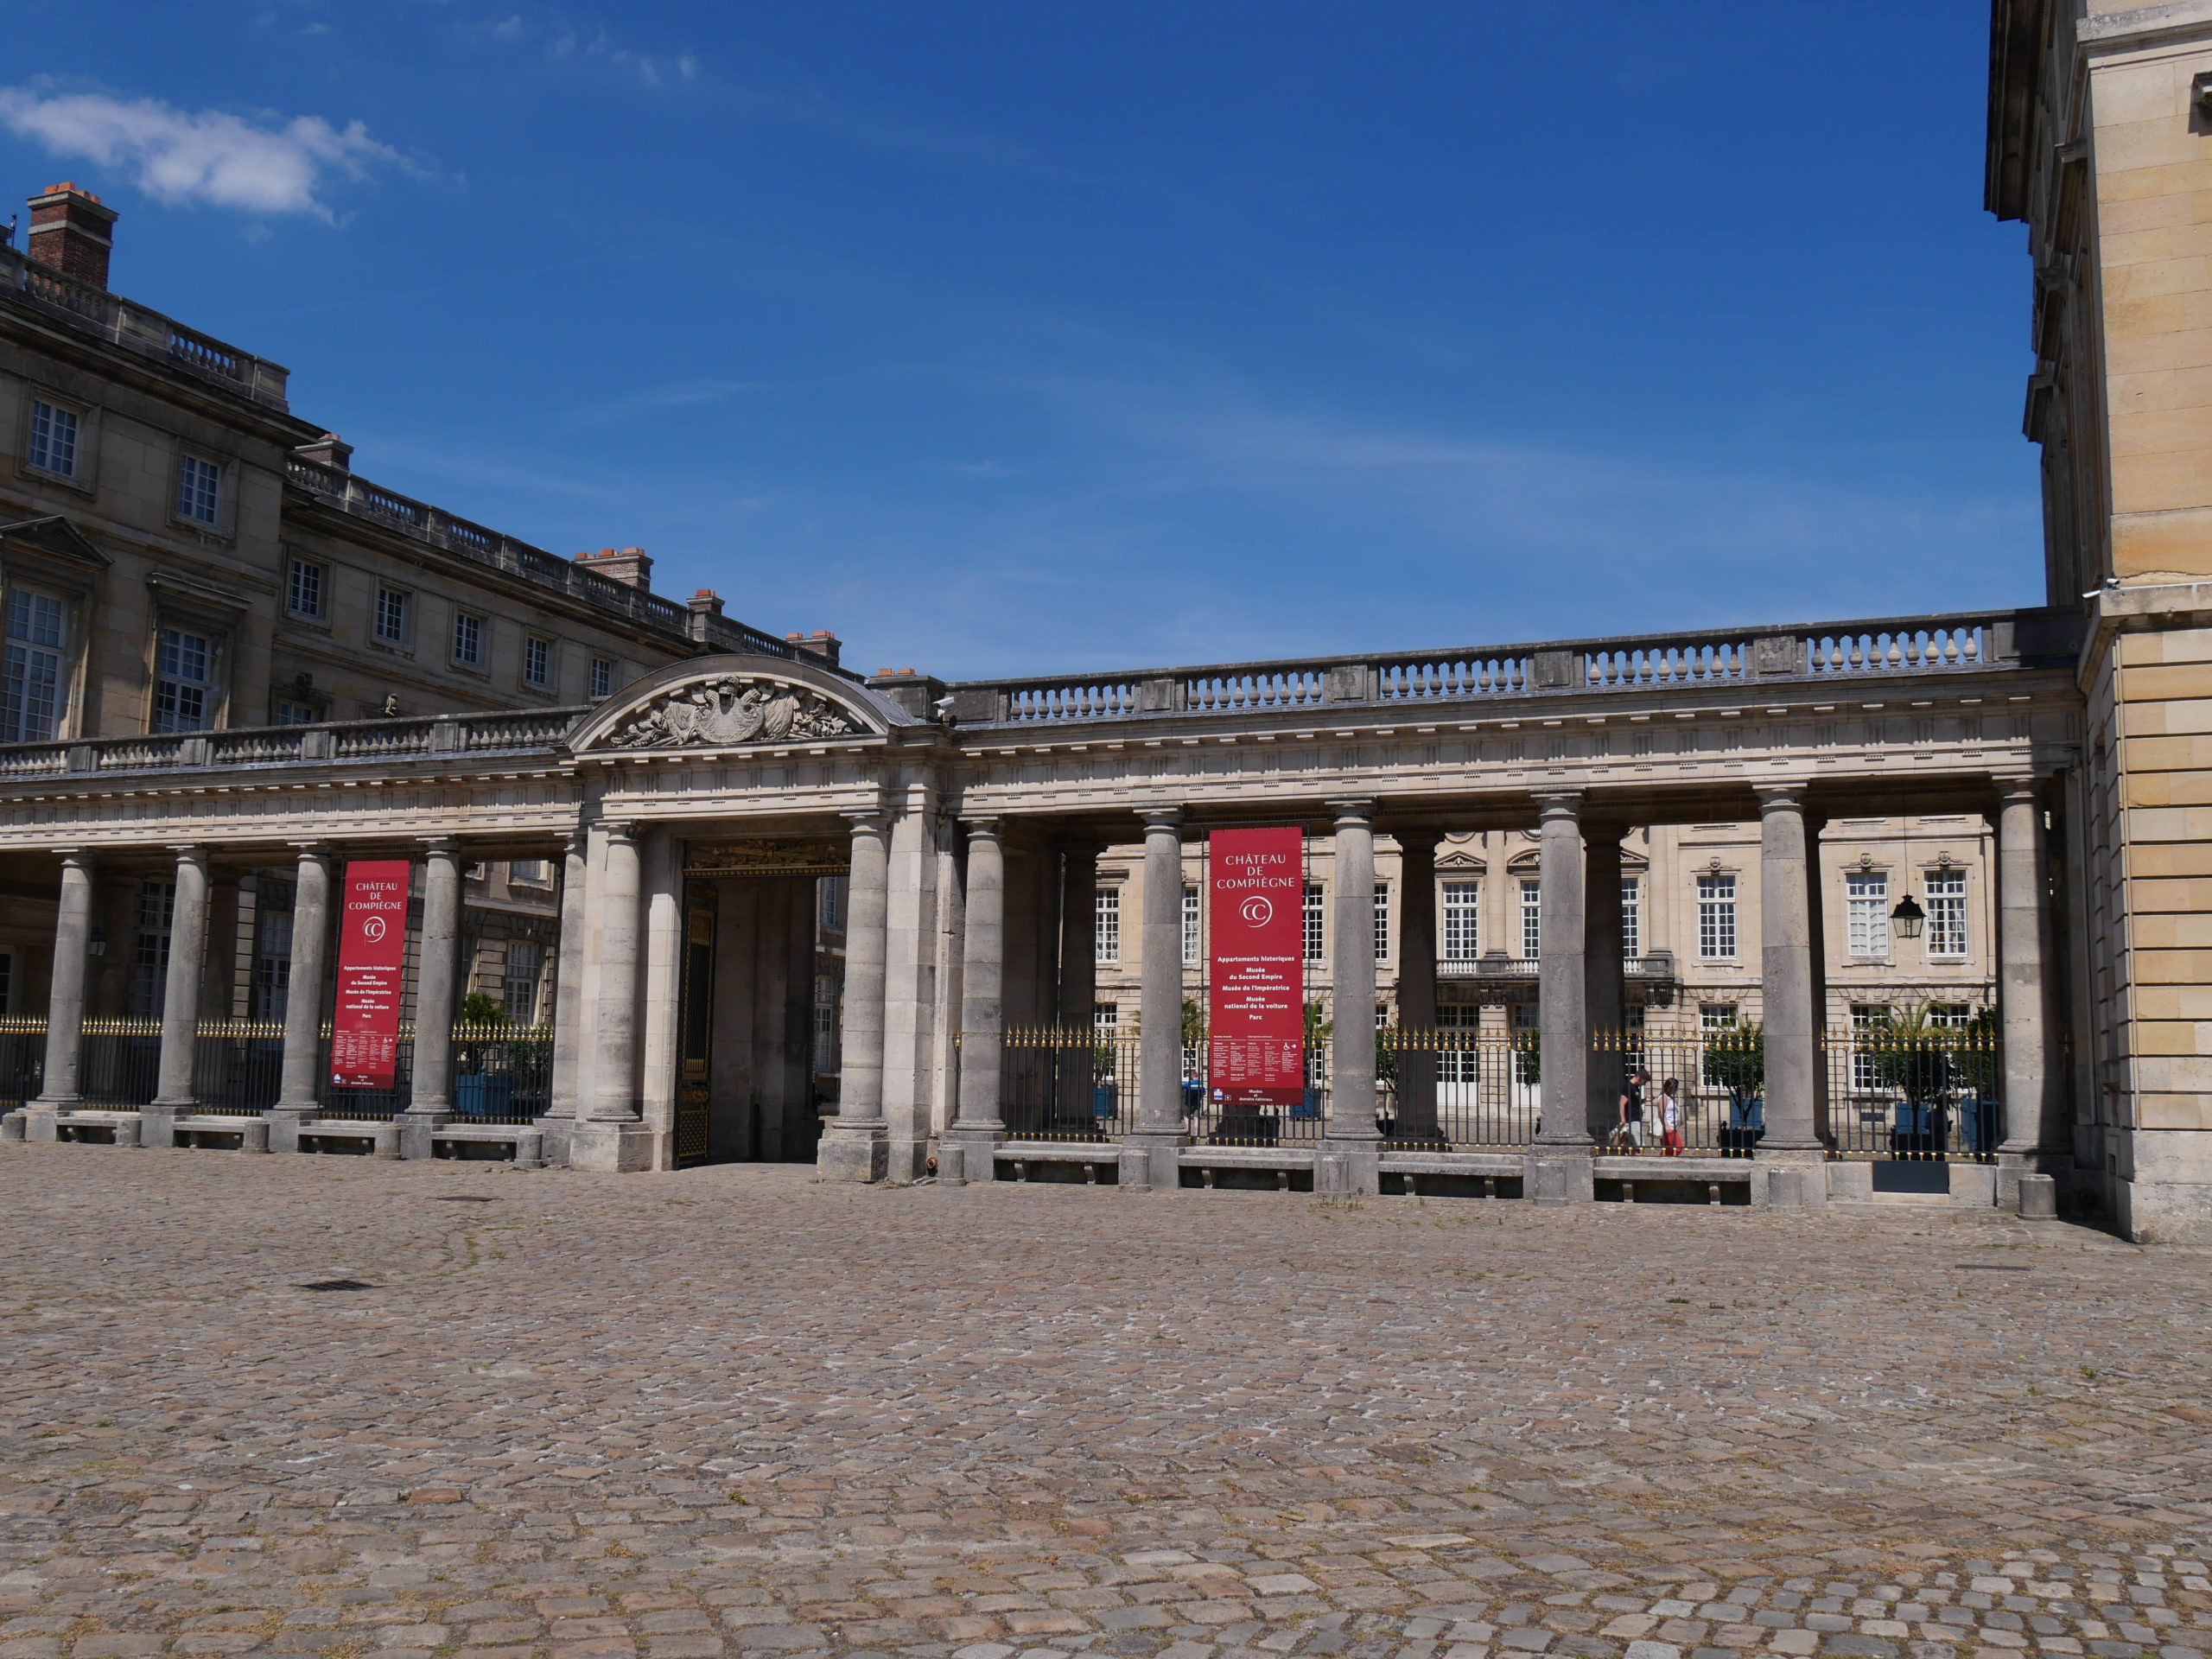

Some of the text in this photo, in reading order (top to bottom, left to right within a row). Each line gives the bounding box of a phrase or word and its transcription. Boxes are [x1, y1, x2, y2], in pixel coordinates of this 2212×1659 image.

[1225, 854, 1286, 865] CHÂTEAU
[1247, 867, 1263, 876] DE
[356, 882, 397, 891] CHÂTEAU
[1217, 876, 1294, 889] COMPIÈGNE
[370, 892, 382, 900] DE
[349, 901, 402, 910] COMPIÈGNE
